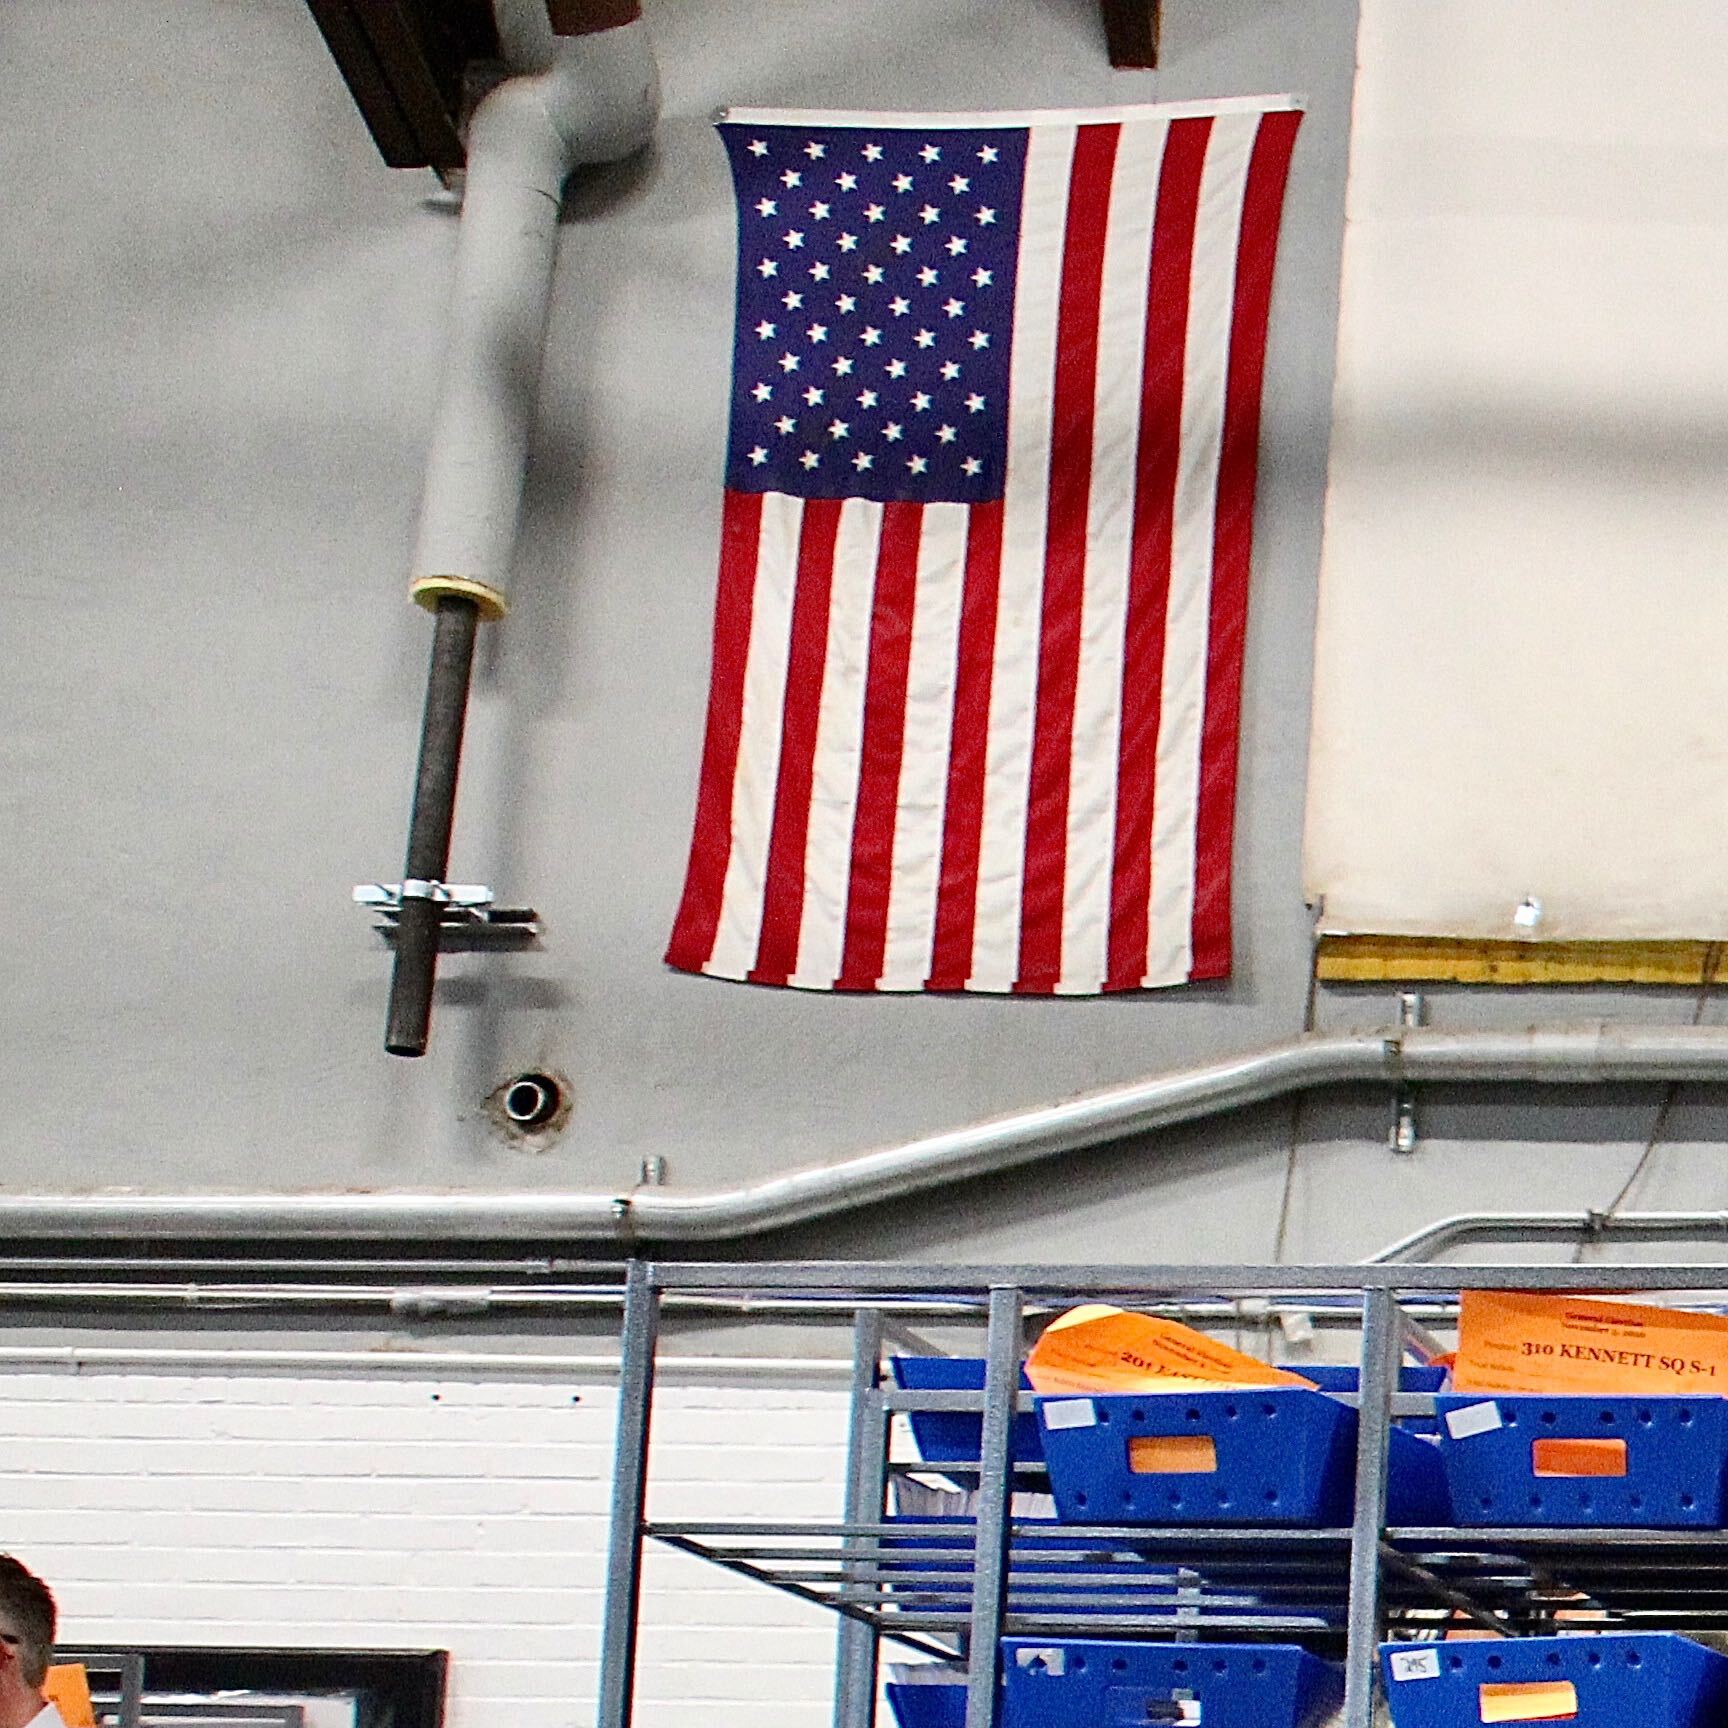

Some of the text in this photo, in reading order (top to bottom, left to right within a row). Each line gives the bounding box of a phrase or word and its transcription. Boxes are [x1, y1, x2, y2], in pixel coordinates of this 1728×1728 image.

[1522, 1342, 1554, 1356] 310
[1560, 1344, 1655, 1368] KENNETT
[1659, 1356, 1684, 1375] SQ
[1690, 1360, 1716, 1376] S-1
